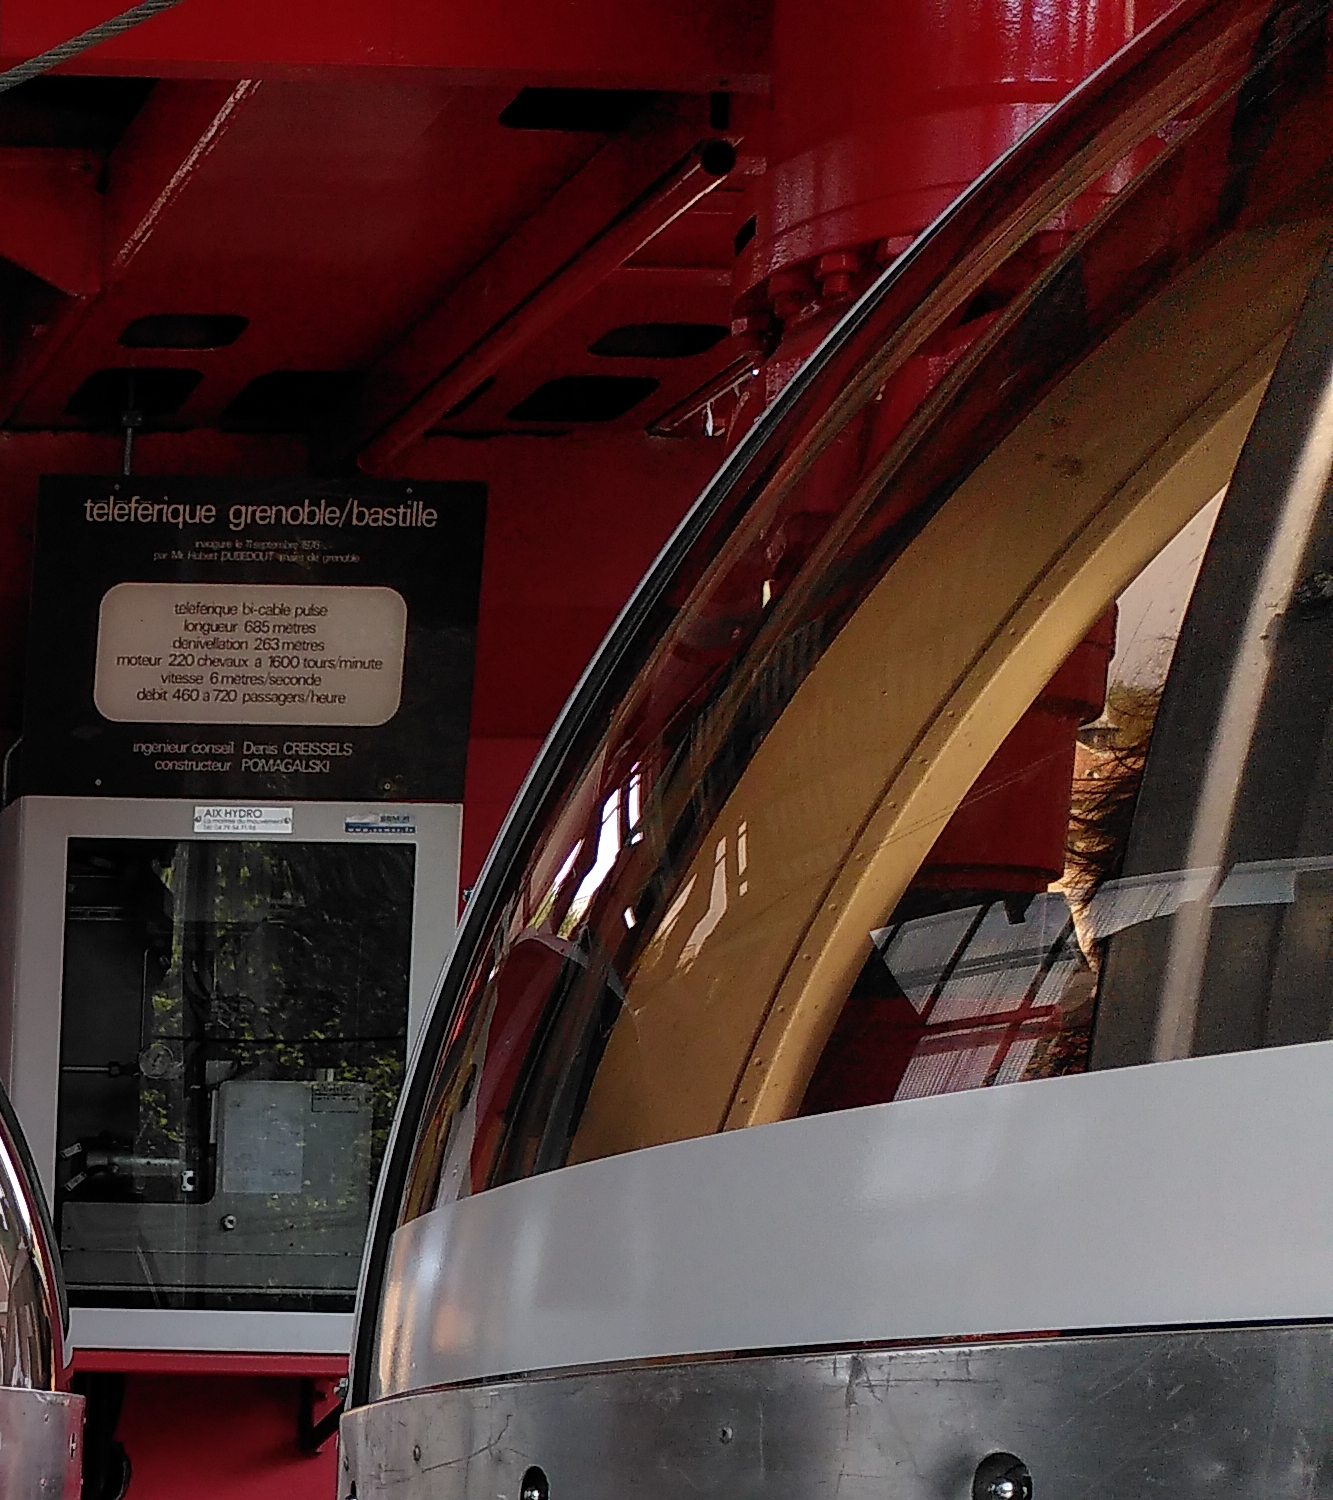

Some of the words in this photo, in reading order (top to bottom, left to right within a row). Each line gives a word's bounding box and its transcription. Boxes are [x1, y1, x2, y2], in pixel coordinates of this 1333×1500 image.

[229, 497, 438, 531] grenoble/bastille
[184, 620, 238, 635] longueur
[244, 620, 270, 634] 685
[253, 637, 280, 651] 263
[116, 654, 162, 667] moteur
[168, 653, 194, 667] 220
[197, 654, 249, 668] chevaux
[268, 655, 300, 669] 1600
[303, 656, 383, 671] tours/minute
[160, 671, 204, 685] vitesse
[209, 672, 219, 685] 6
[172, 688, 200, 702] 460
[213, 689, 238, 703] 720
[242, 690, 346, 706] passagers/heure
[192, 741, 235, 756] conseil
[243, 741, 278, 756] Denis
[283, 741, 353, 757] CREISSELS
[155, 759, 231, 771] constructeur
[241, 758, 331, 773] POMAGALSKI
[204, 808, 222, 818] AIX
[224, 808, 263, 819] HYDRO
